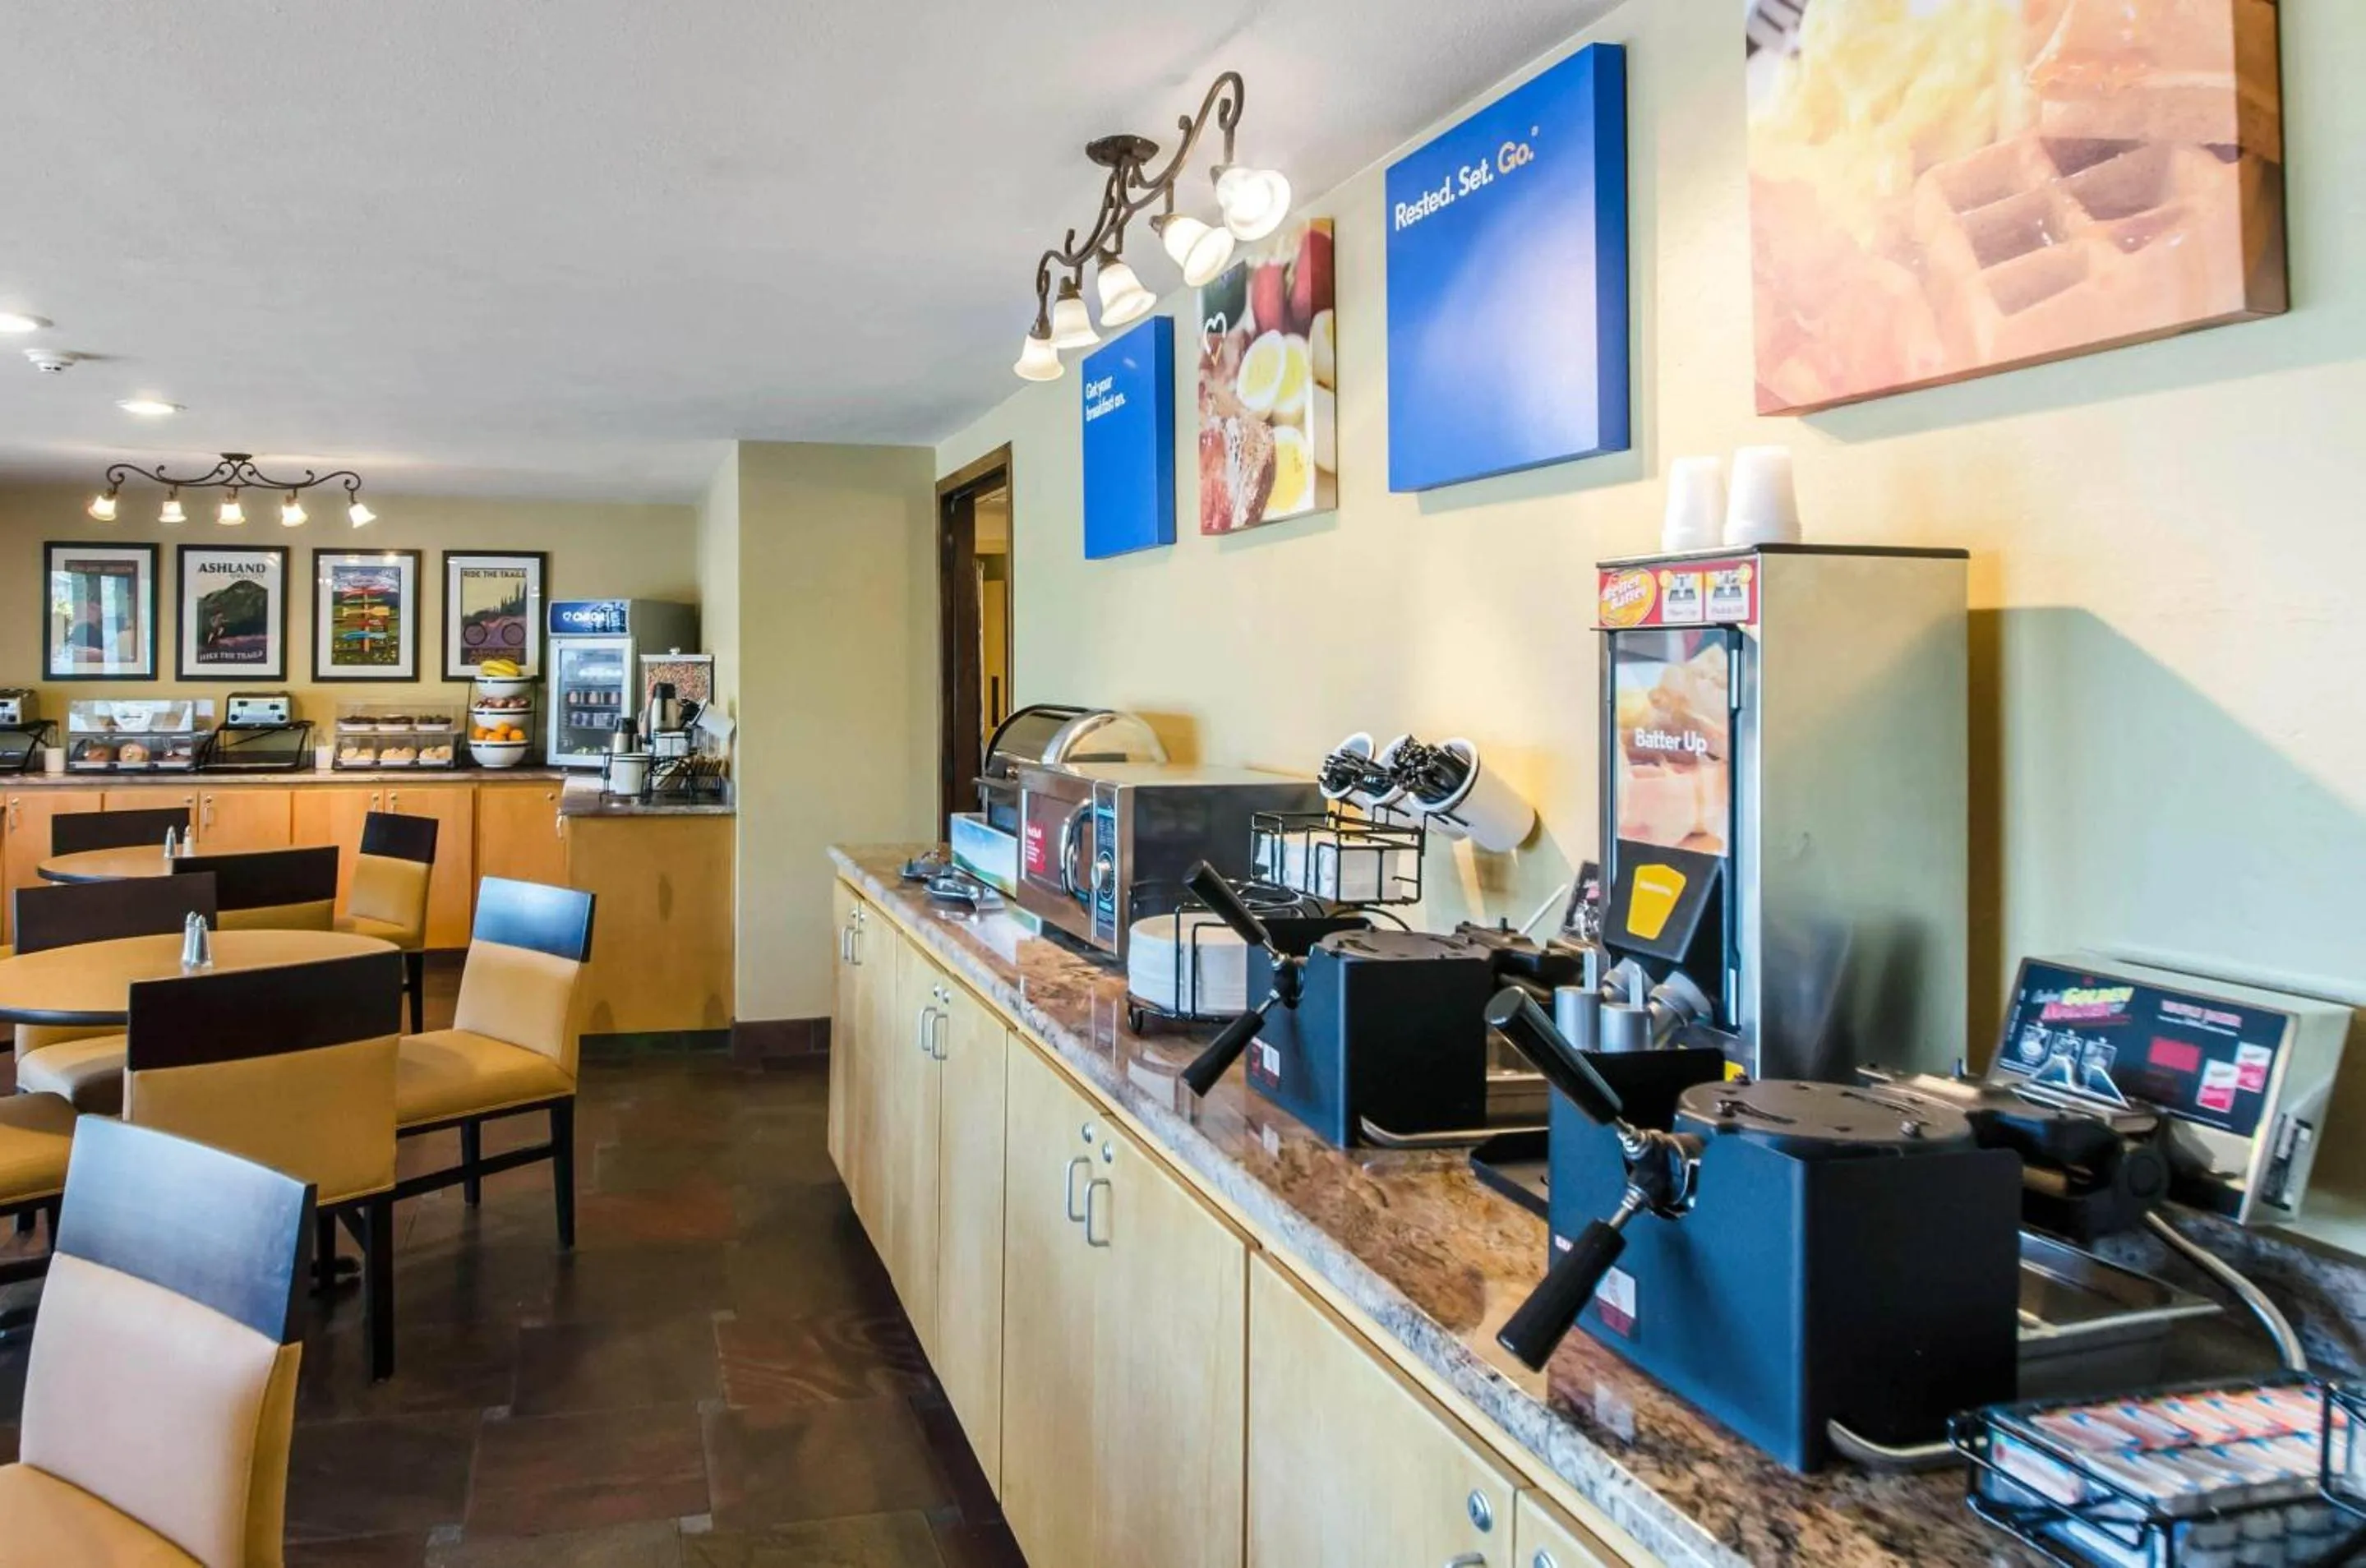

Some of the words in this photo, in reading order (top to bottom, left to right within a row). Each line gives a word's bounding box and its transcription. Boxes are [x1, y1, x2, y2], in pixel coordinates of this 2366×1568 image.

[1395, 175, 1455, 231] Rested.
[1458, 158, 1494, 197] Set.
[1497, 141, 1534, 174] Go.
[1086, 380, 1098, 400] Get
[1097, 375, 1113, 398] your
[1086, 394, 1114, 422] breakfast
[1114, 392, 1126, 408] on.
[198, 562, 266, 574] ASHLAND
[463, 570, 481, 579] RIDE
[483, 570, 497, 579] THE
[219, 651, 236, 660] THE
[1633, 726, 1681, 750] Batter
[1683, 730, 1708, 757] Up
